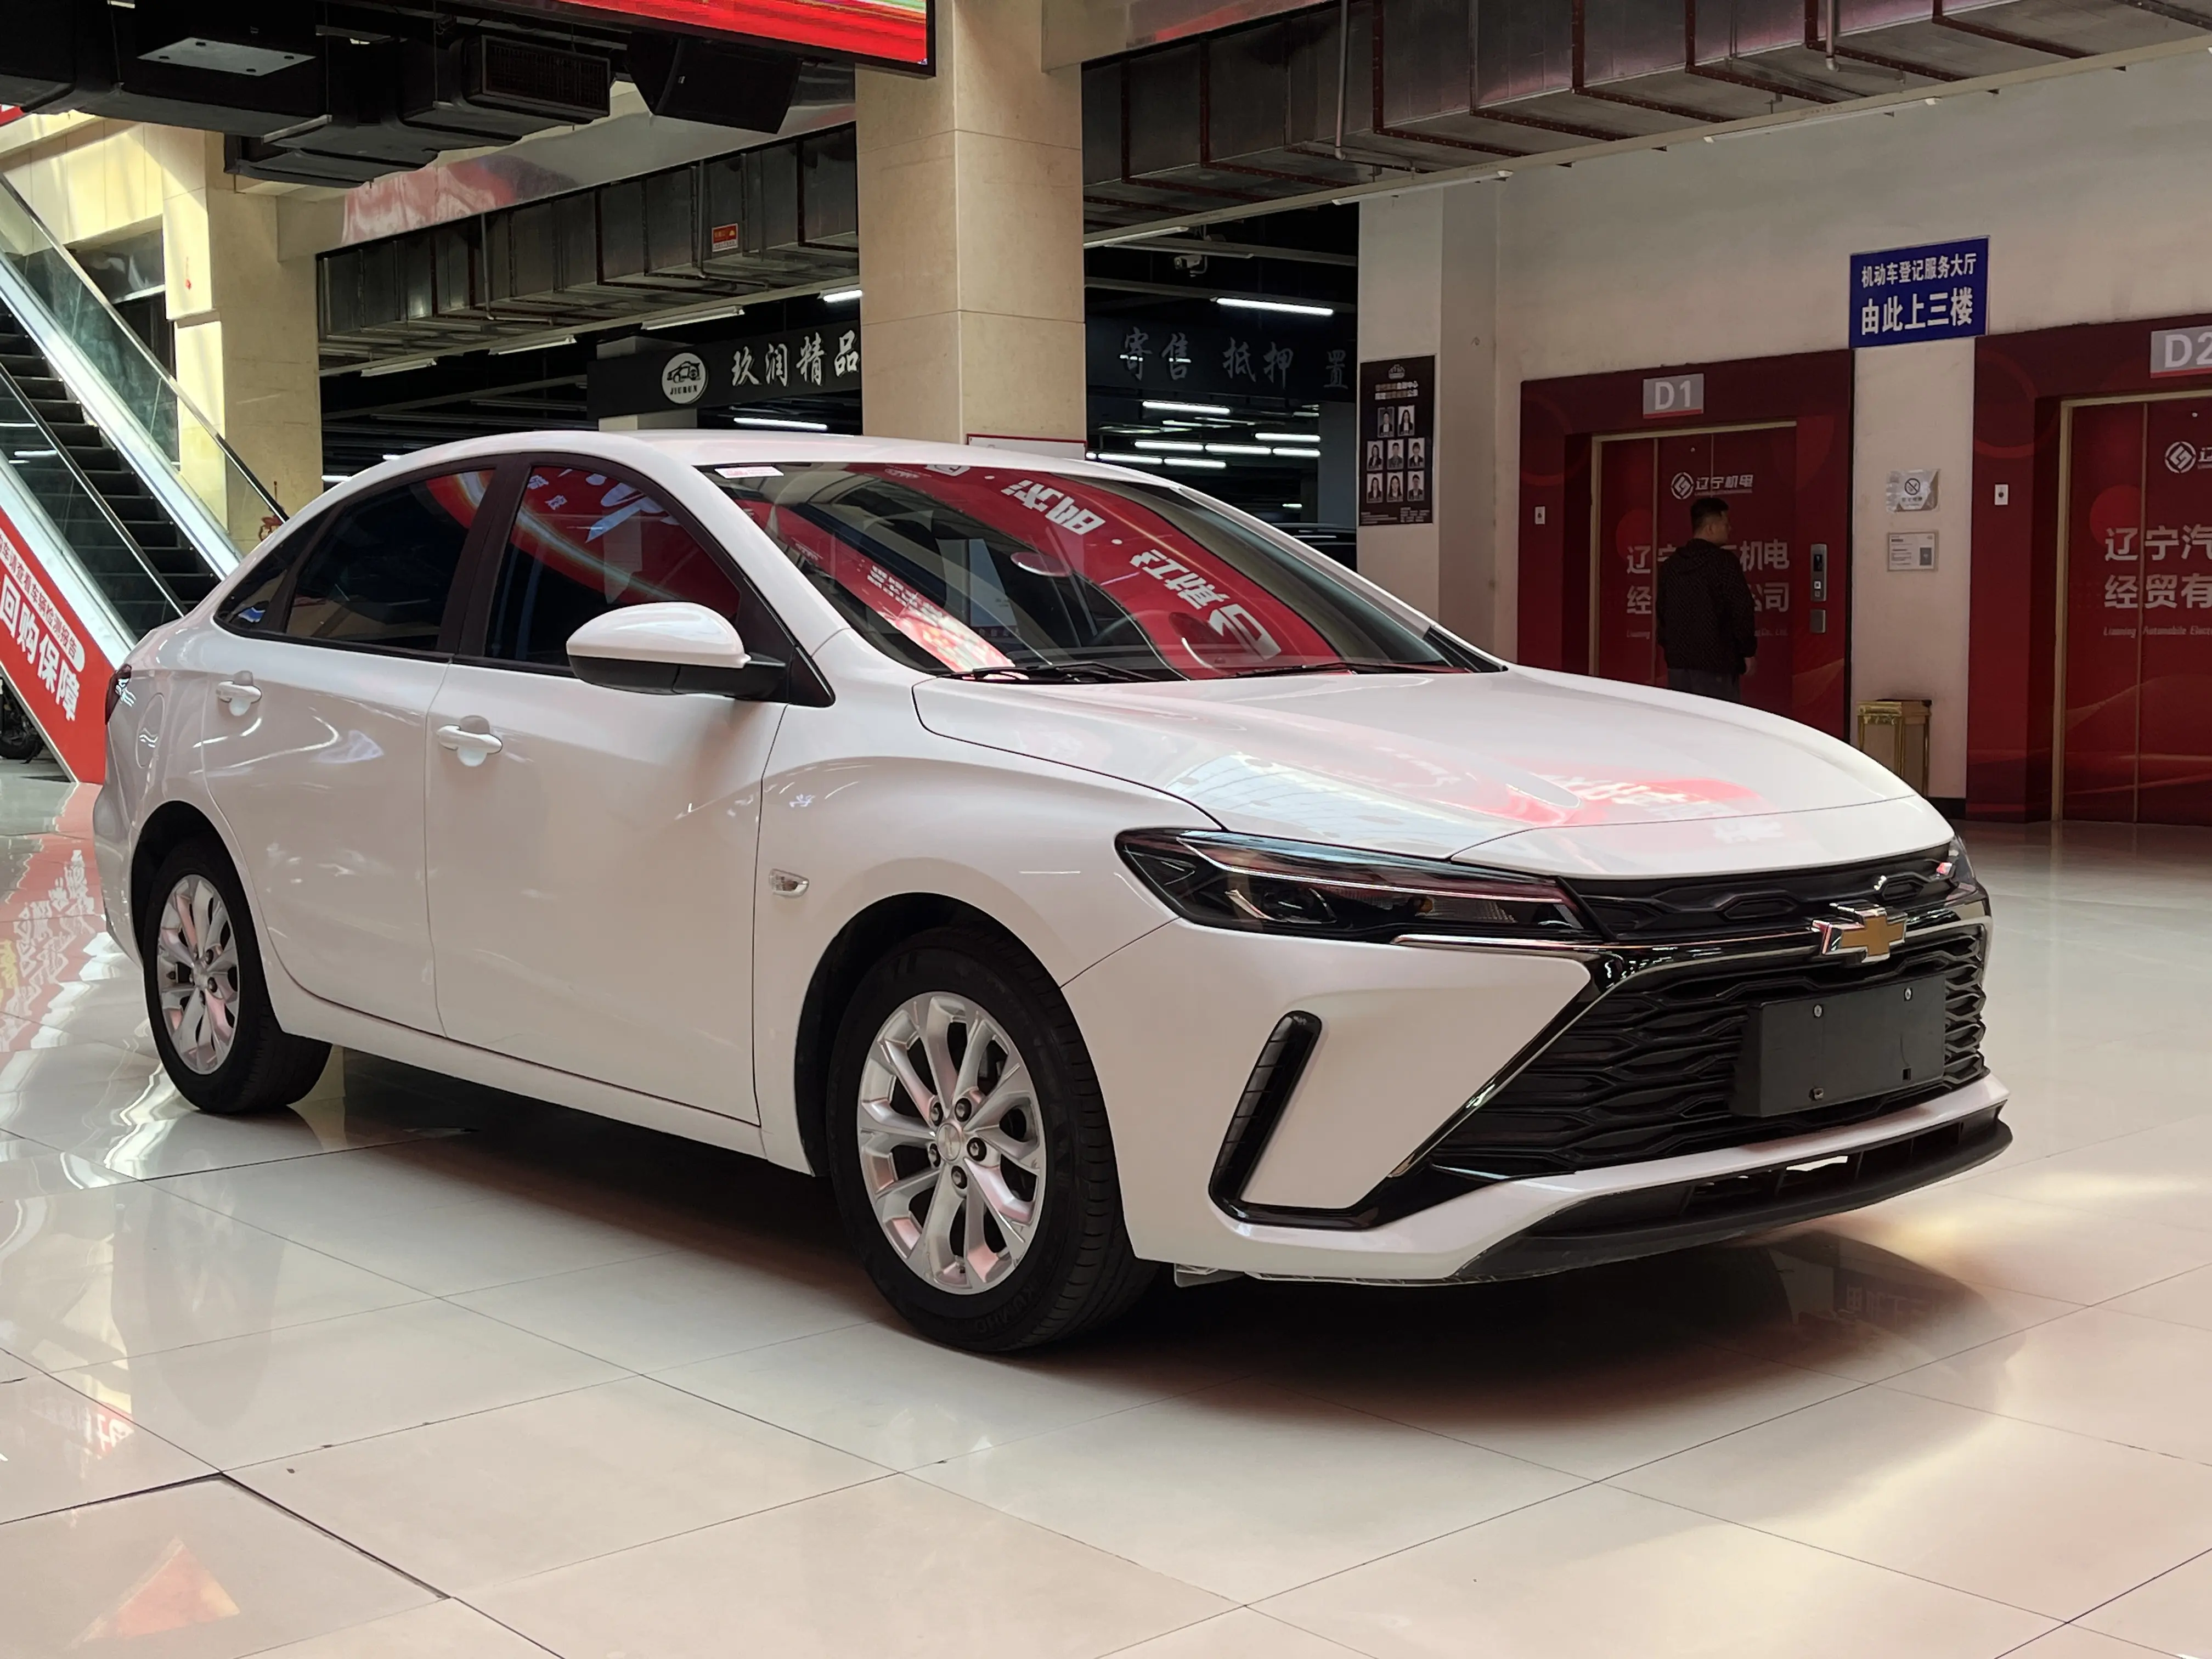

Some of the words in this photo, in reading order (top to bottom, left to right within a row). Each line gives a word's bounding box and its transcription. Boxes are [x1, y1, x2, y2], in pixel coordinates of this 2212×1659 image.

[1861, 253, 1977, 288] 机动车登记服务大厅
[1861, 286, 1973, 335] 由此上三楼
[731, 330, 861, 387] 玖润精品
[1121, 327, 1190, 381] 寄售
[1222, 337, 1294, 390] 抵押
[1323, 349, 1348, 390] 置
[2164, 331, 2212, 368] D2
[1654, 380, 1691, 410] D1
[1696, 475, 1753, 490] 辽宁机电
[2104, 524, 2212, 561] 辽宁汽
[2104, 573, 2212, 608] 经贸有
[0, 574, 80, 721] 回购保障
